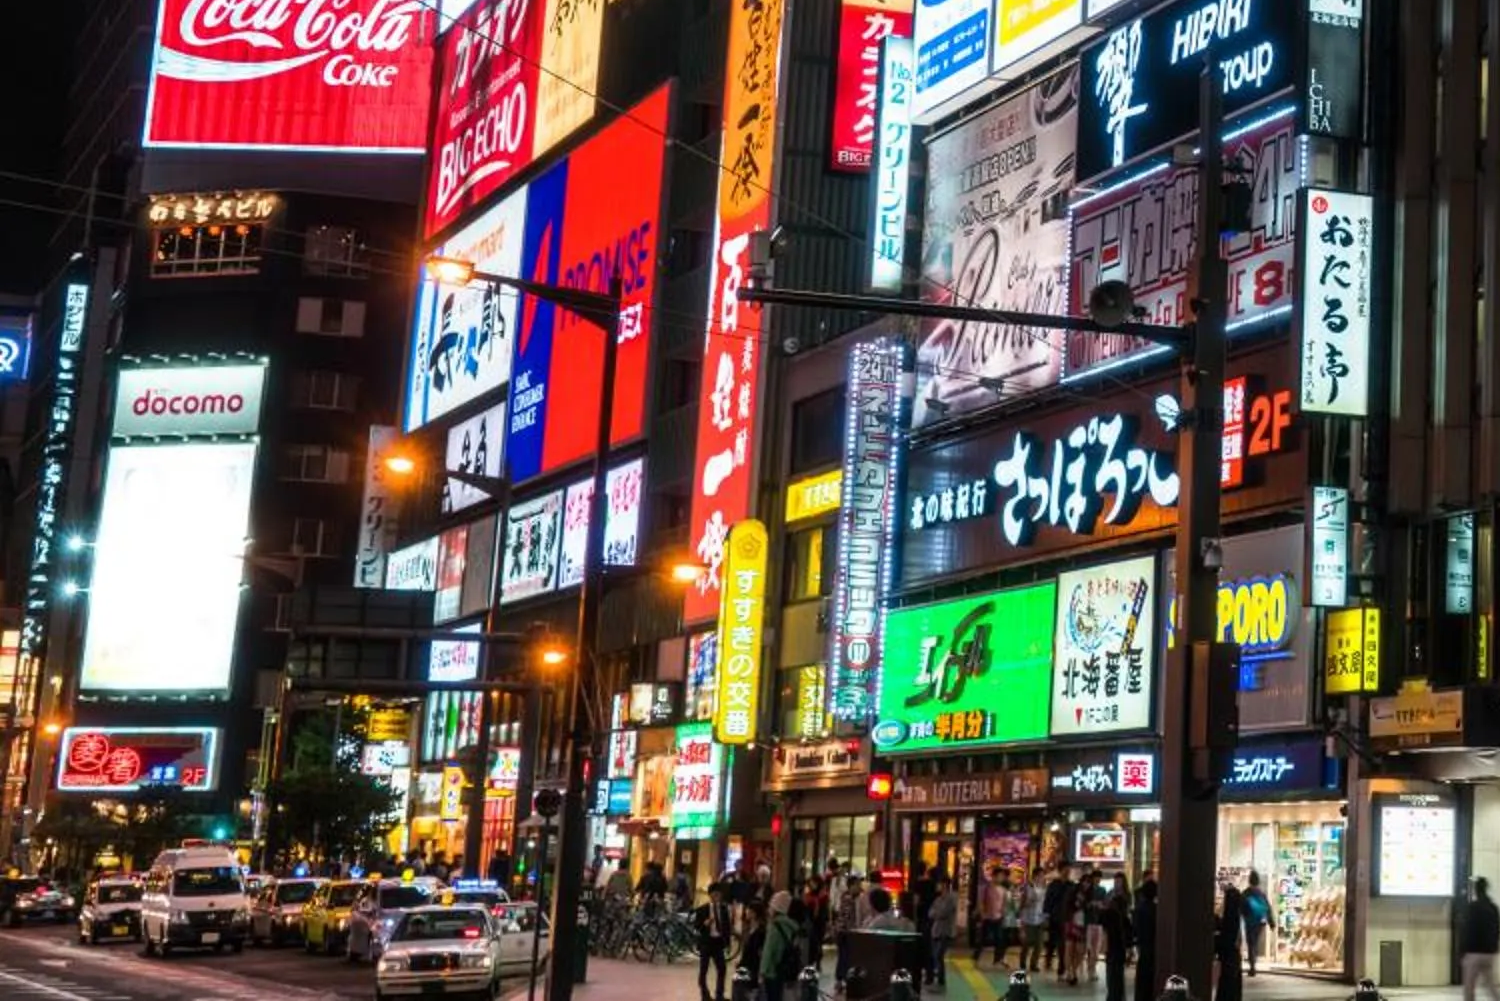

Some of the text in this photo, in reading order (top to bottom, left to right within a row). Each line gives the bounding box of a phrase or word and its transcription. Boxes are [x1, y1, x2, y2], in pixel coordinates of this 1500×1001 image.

[322, 53, 400, 89] Coke
[1219, 41, 1274, 94] roup
[435, 127, 473, 215] BIG
[473, 81, 527, 164] ECHO
[877, 121, 908, 262] グリーンビル
[1319, 214, 1355, 406] おたる亭
[132, 389, 245, 417] docomo
[1249, 390, 1291, 456] 2F
[911, 478, 987, 530] 北の味紀行
[724, 568, 758, 737] すすきの交番
[181, 768, 207, 785] 2F
[932, 779, 991, 802] LOTTERIA
[1123, 759, 1150, 788] 薬
